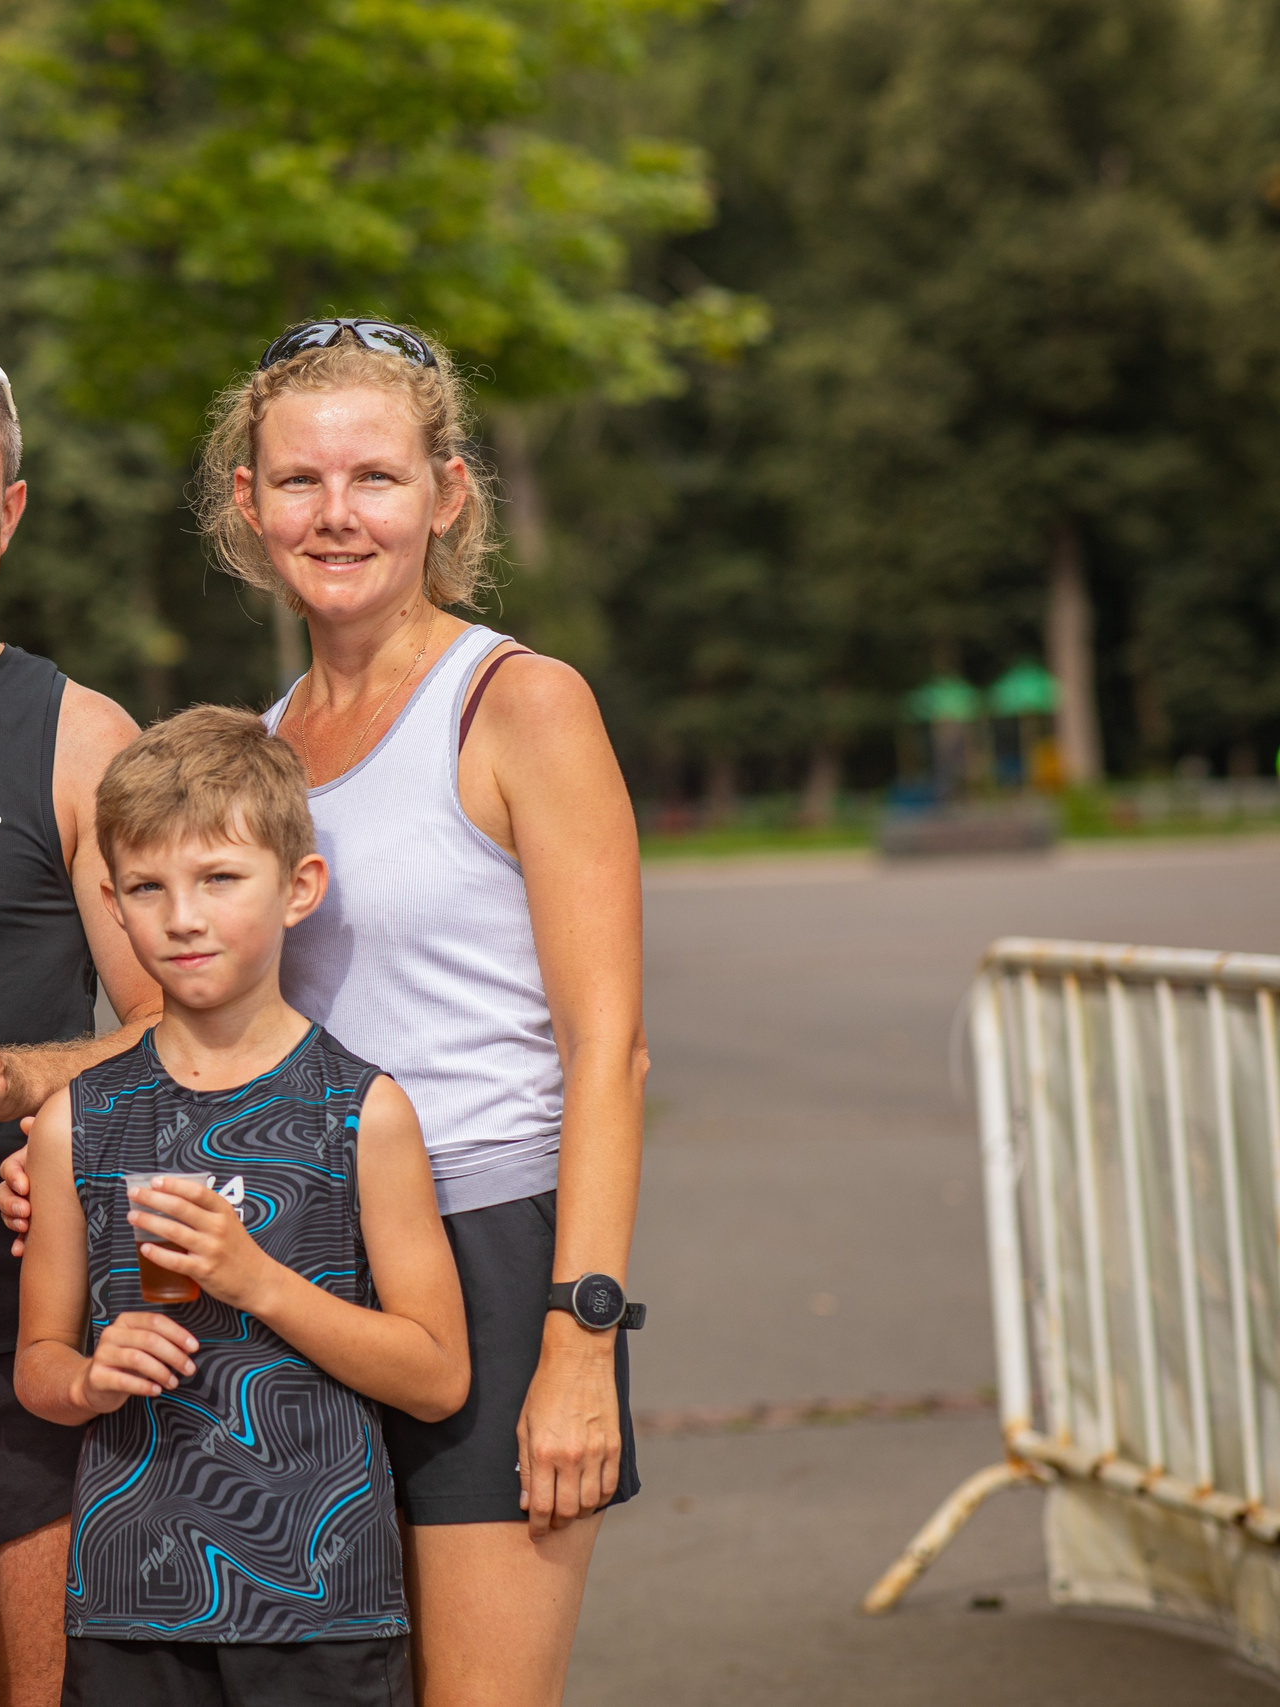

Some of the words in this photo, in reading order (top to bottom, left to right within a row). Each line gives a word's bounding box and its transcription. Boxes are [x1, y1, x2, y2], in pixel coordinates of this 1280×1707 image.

[155, 1110, 190, 1157] FILA
[178, 1121, 199, 1142] PRO
[313, 1112, 339, 1160] FIA
[592, 1289, 608, 1314] 9:05
[201, 1406, 240, 1456] FILA
[139, 1533, 176, 1583] FILA
[166, 1545, 186, 1568] PRO
[308, 1532, 346, 1584] FILA
[336, 1542, 356, 1567] PRO
